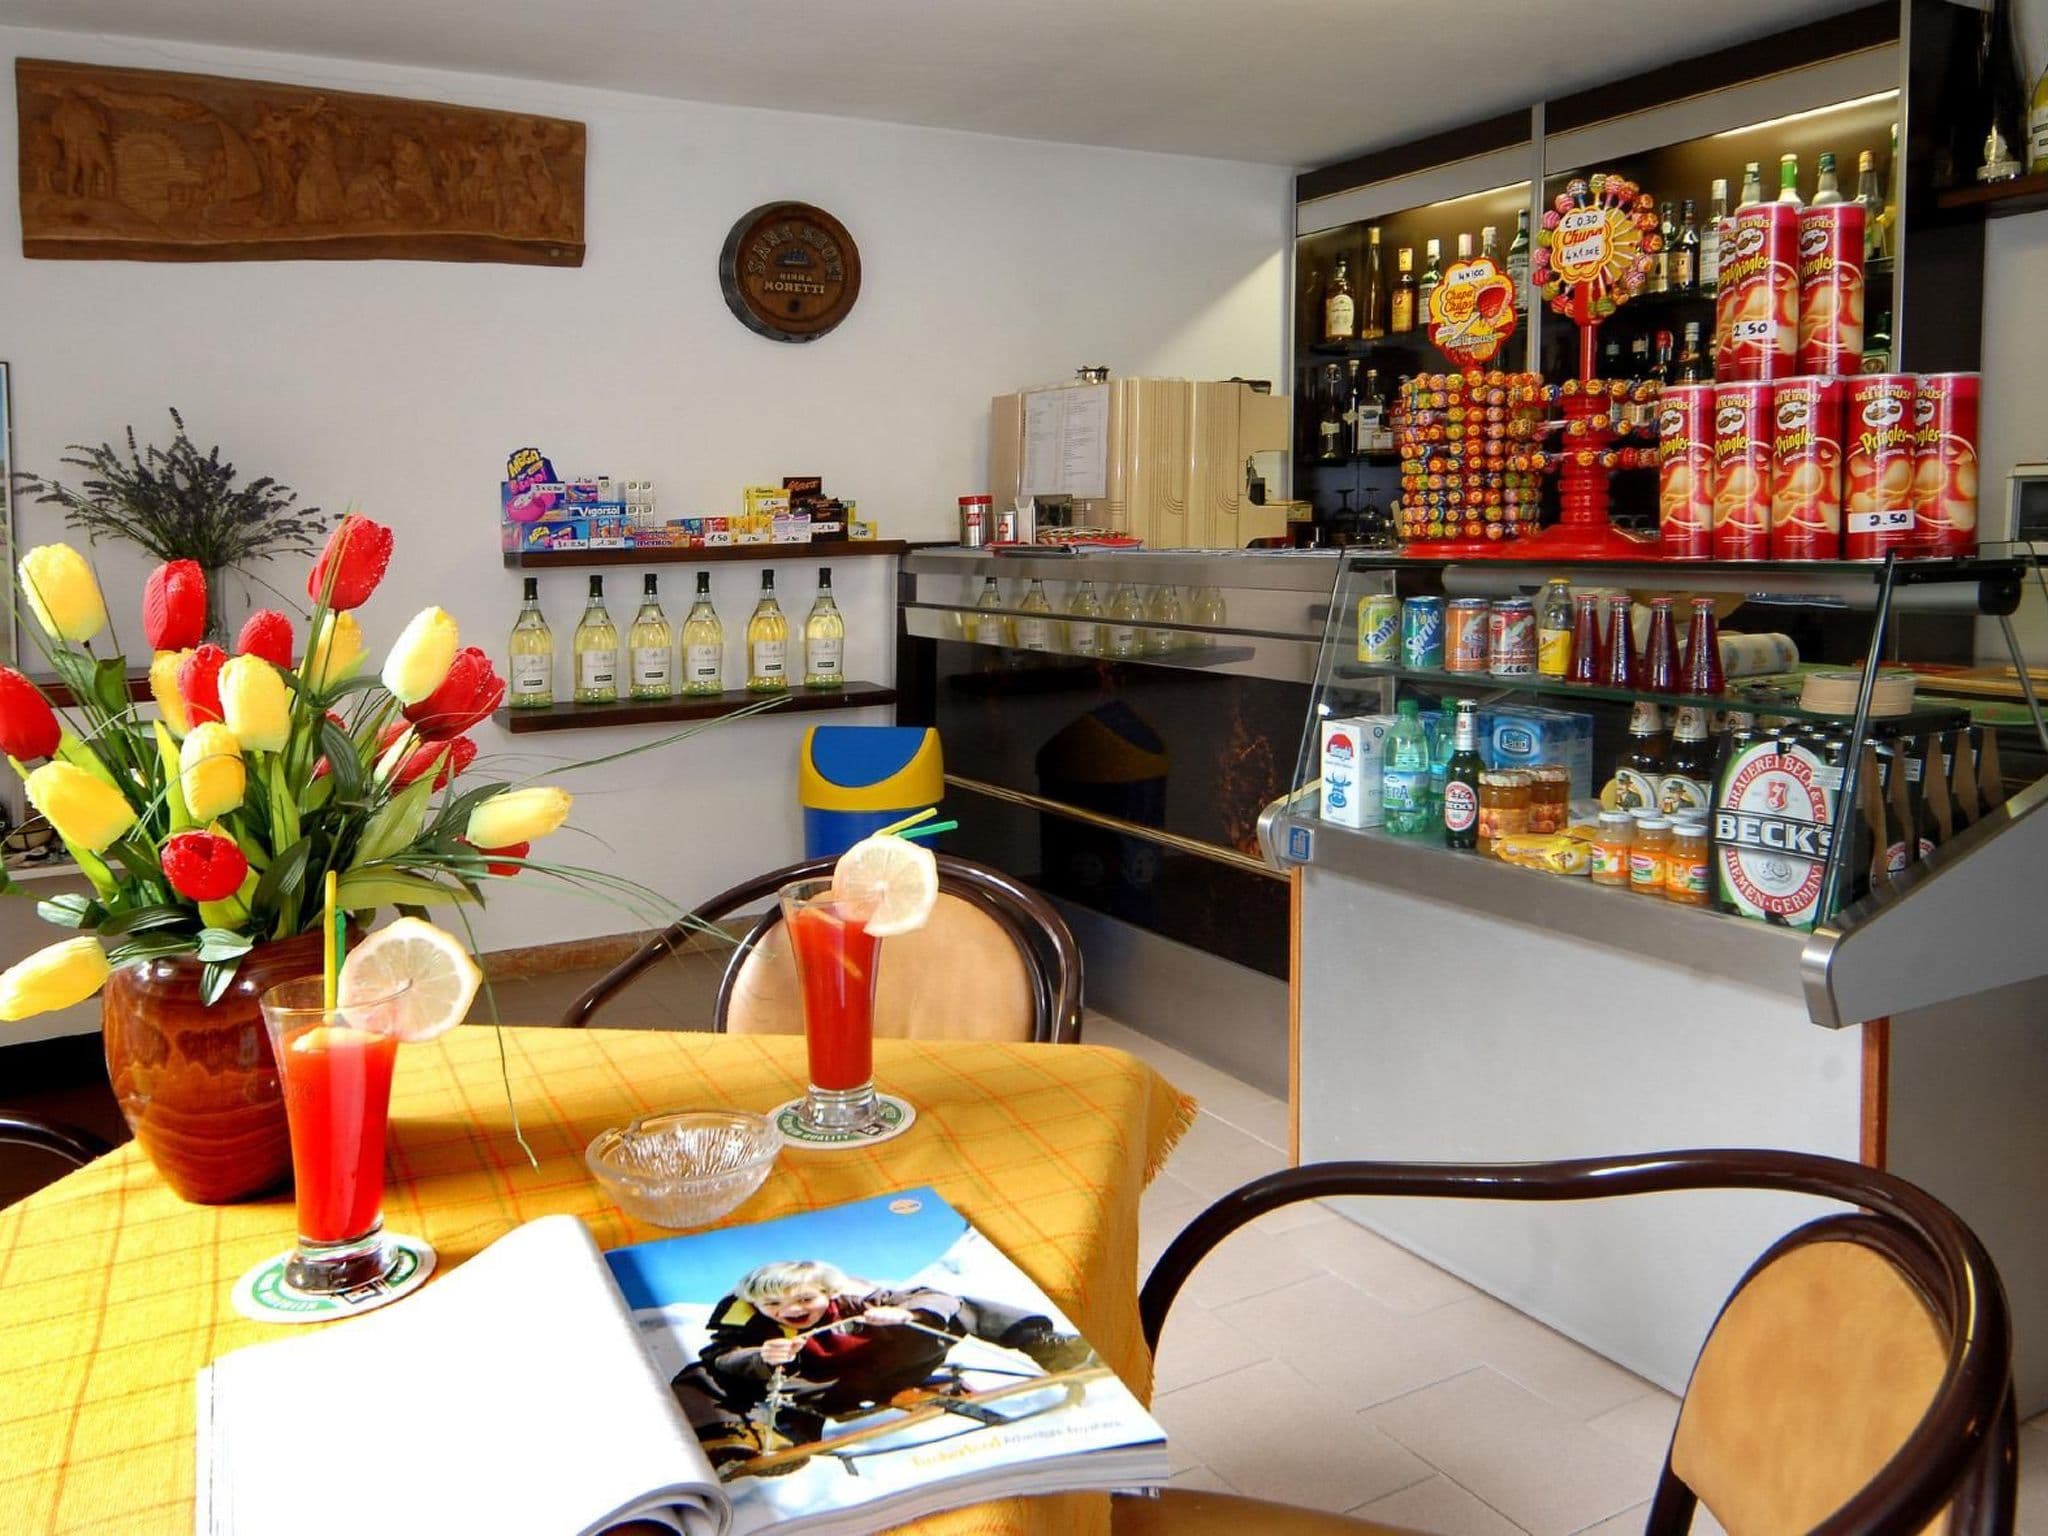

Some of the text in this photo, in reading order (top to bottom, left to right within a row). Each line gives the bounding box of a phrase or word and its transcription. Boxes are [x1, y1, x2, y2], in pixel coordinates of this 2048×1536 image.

[764, 281, 825, 294] MORETTI
[1776, 427, 1816, 458] Pringles
[1860, 424, 1906, 455] Pringles
[578, 504, 621, 517] Vigorsol
[636, 539, 672, 547] mentos
[1364, 614, 1400, 649] Fanta
[1406, 610, 1440, 656] Sprite
[1727, 755, 1780, 809] BRAUEREI
[1716, 813, 1832, 857] BECK'S
